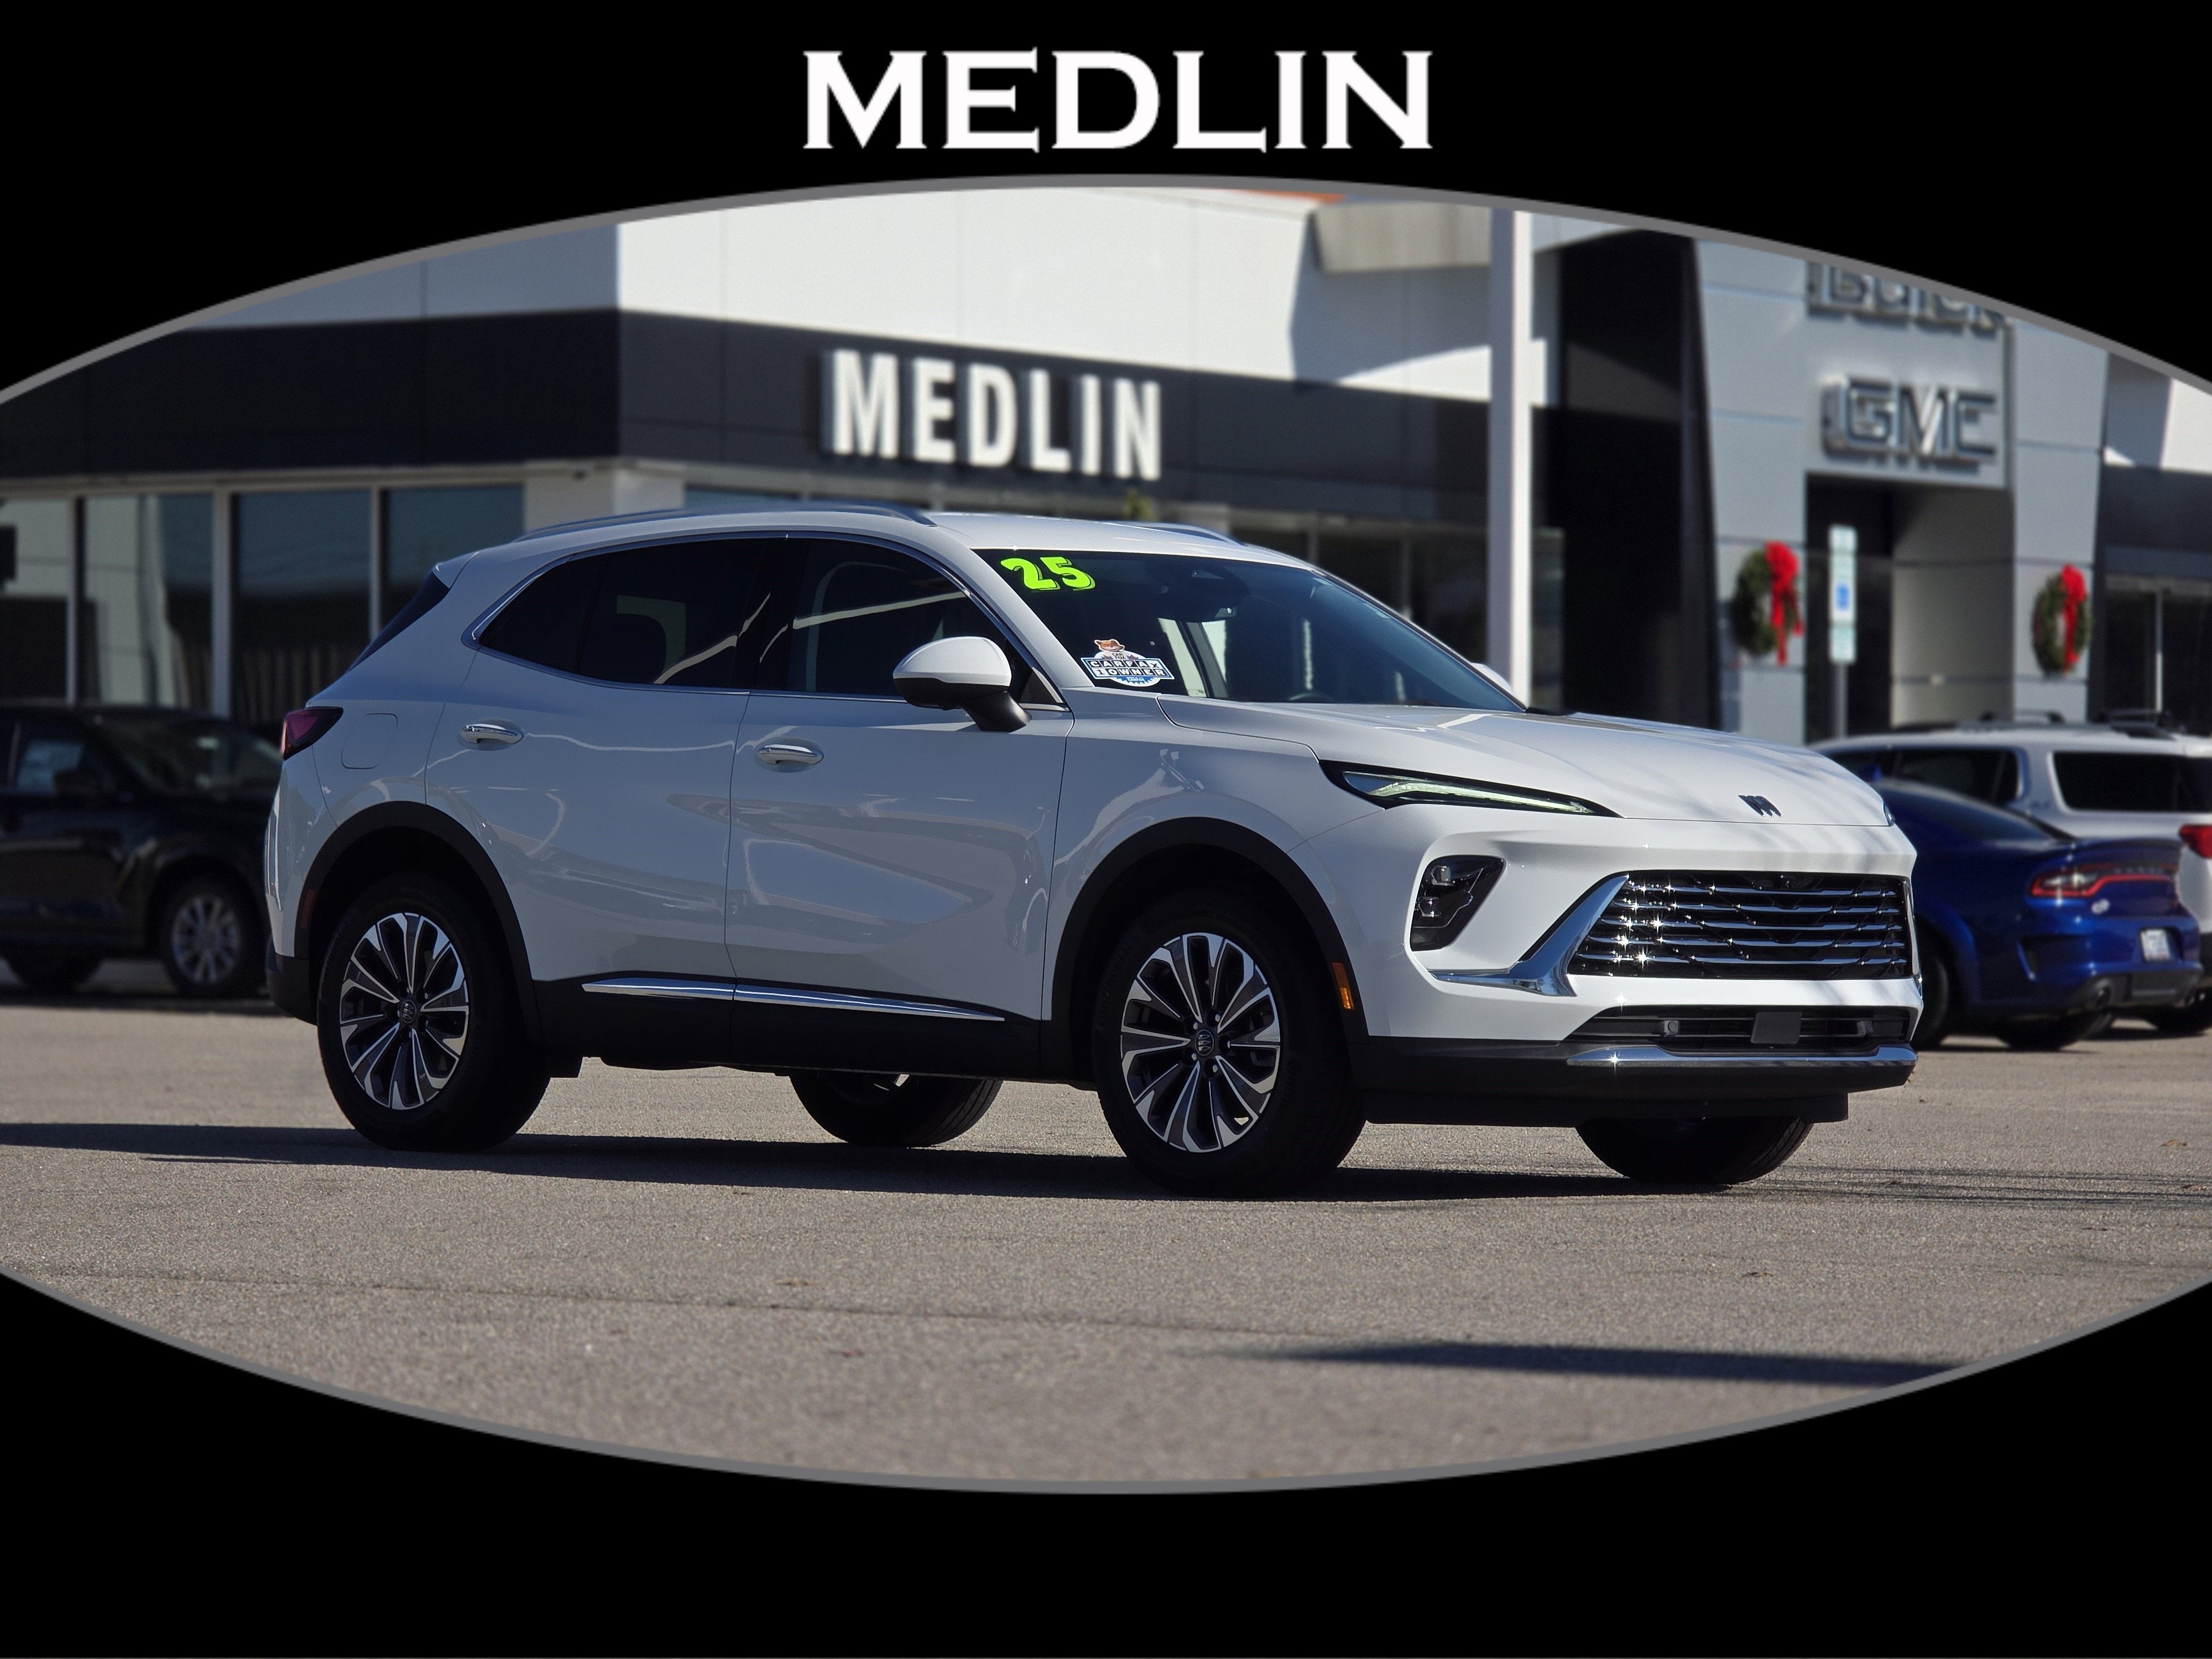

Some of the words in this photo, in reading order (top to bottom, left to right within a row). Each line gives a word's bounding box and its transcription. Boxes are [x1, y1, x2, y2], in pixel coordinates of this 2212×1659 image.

[830, 349, 1161, 481] MEDLIN
[1824, 379, 1995, 463] GMC
[1000, 556, 1096, 591] 25
[1090, 660, 1160, 669] CARFAX
